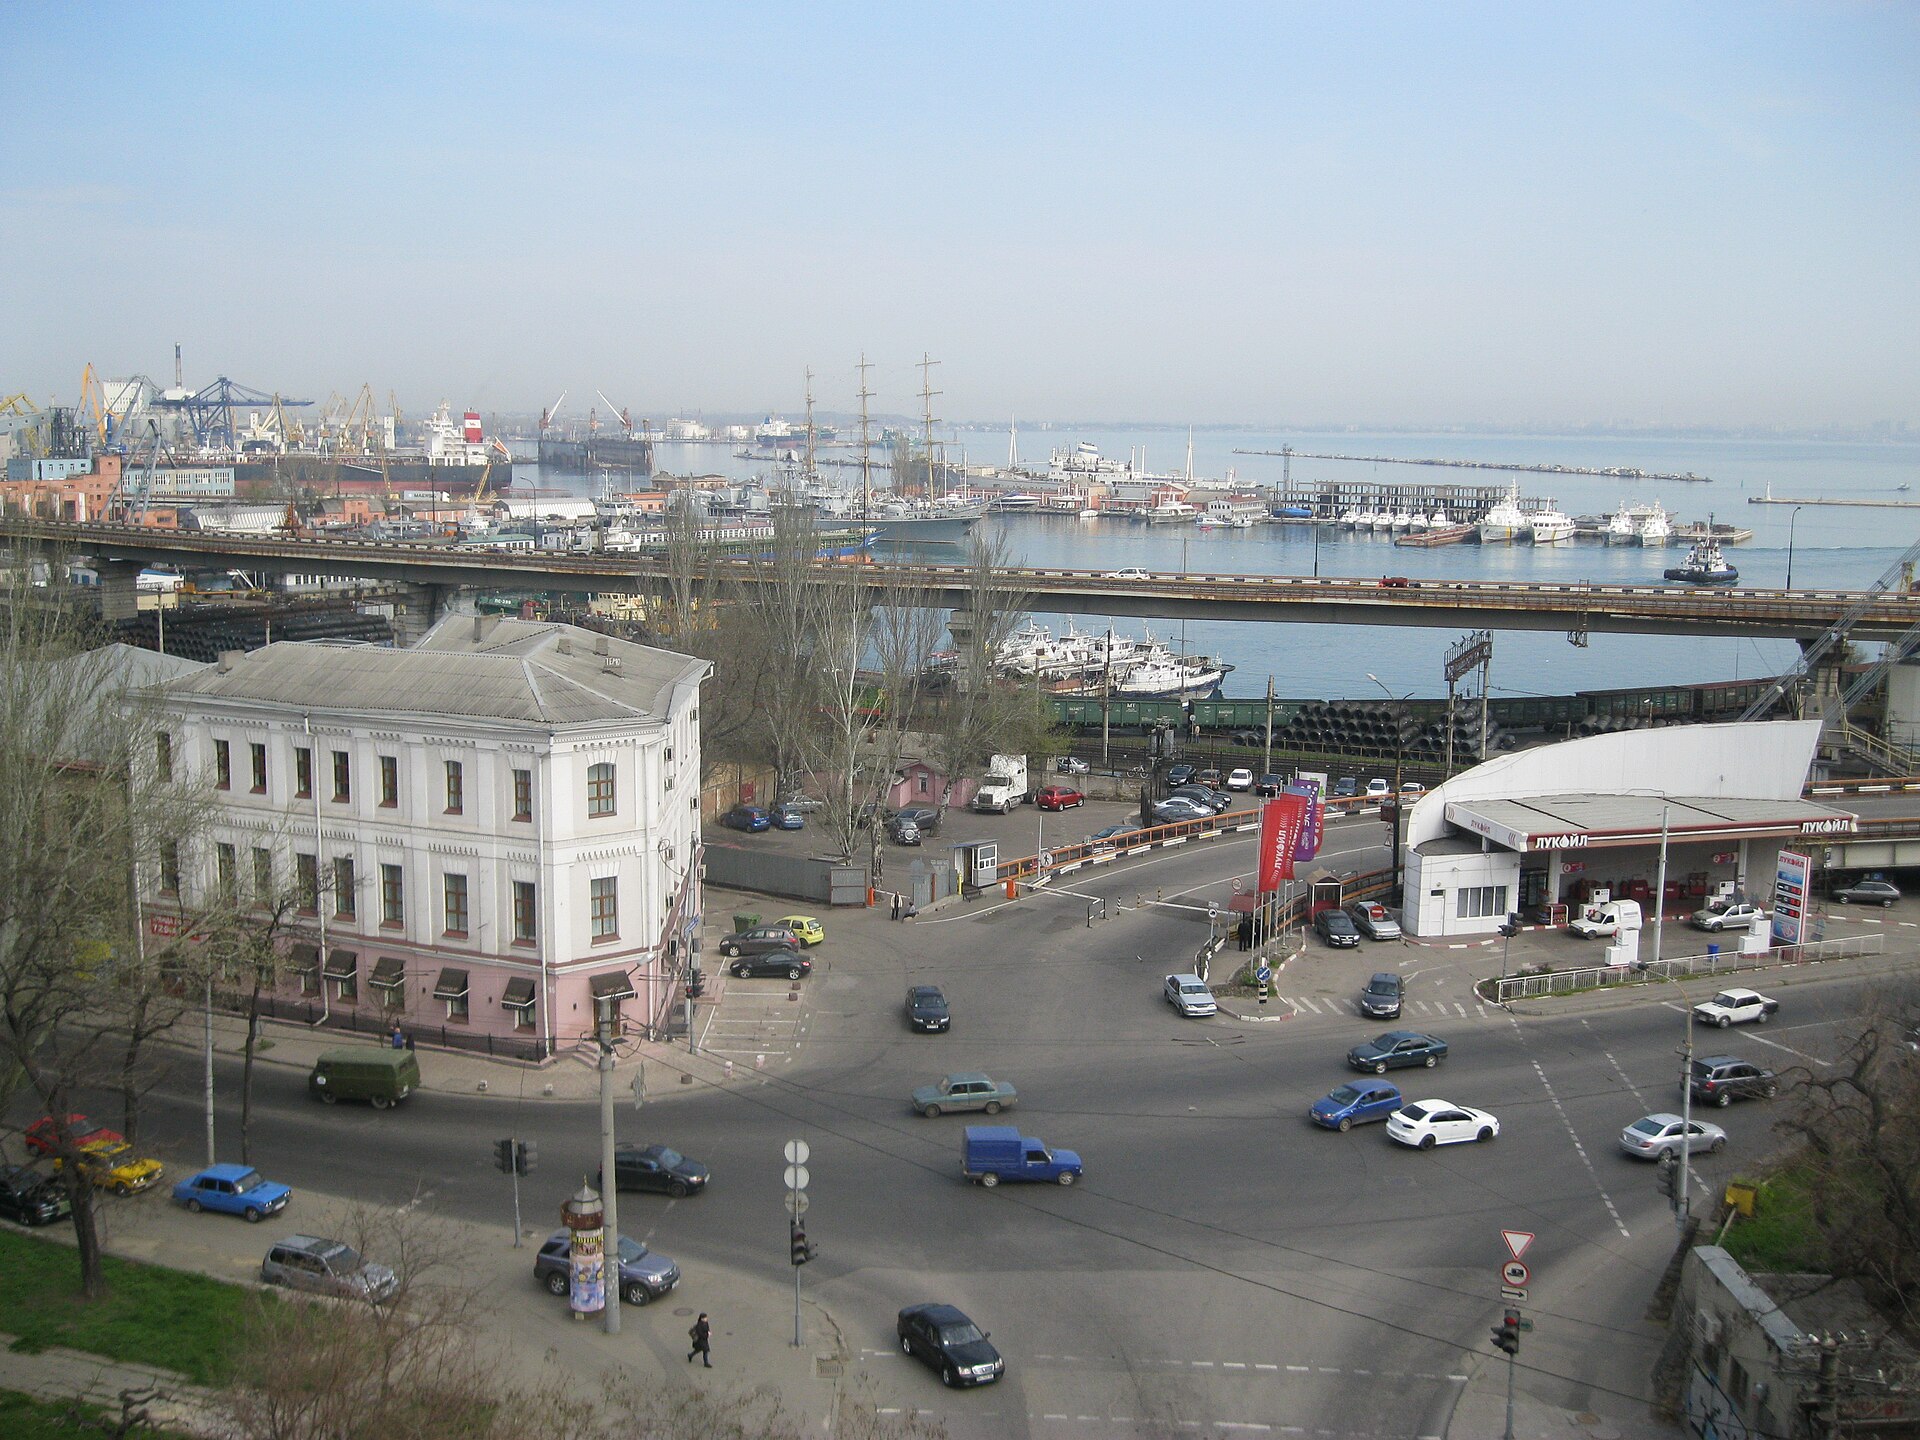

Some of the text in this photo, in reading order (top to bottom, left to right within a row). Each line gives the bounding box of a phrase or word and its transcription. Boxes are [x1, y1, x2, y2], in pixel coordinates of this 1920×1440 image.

[1471, 820, 1490, 834] ЛУКОЙЛ
[1801, 819, 1848, 833] ЛУКОЙЛ
[1535, 834, 1588, 848] ЛУКОЙЛ
[1274, 830, 1287, 870] ЛУКОЙЛ
